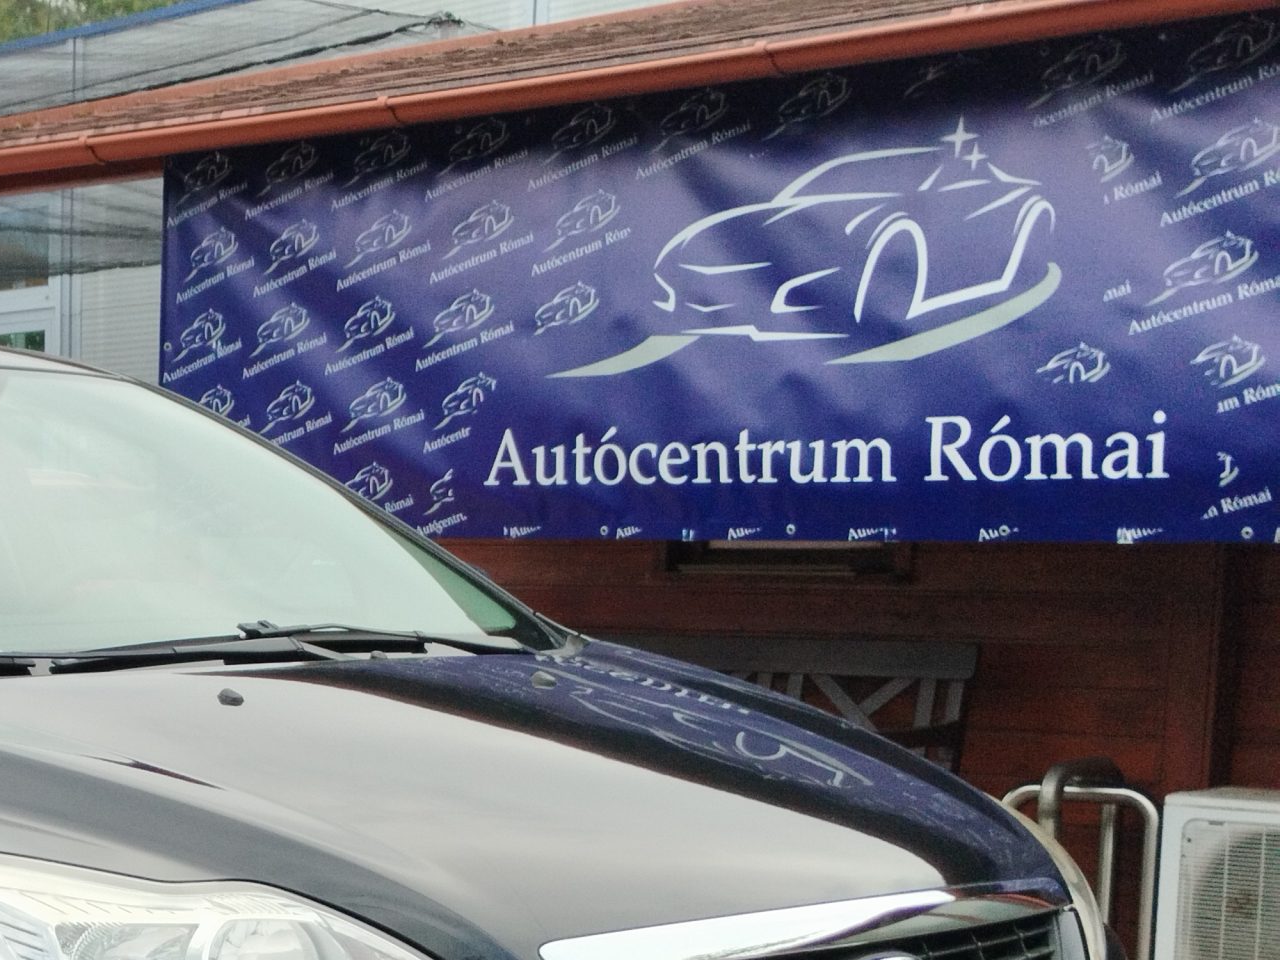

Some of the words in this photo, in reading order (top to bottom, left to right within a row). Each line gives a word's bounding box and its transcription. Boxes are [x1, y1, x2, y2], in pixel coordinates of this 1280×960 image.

[1160, 180, 1260, 227] Autócentrum
[176, 271, 225, 304] Autócentrum
[227, 256, 255, 277] Római
[252, 264, 307, 298] Autócentrum
[308, 248, 337, 271] Római
[336, 254, 397, 292] Autócentrum
[399, 240, 431, 264] Római
[429, 248, 497, 284] Autócentrum
[499, 231, 534, 255] Római
[530, 238, 603, 277] Autócentrum
[1128, 292, 1233, 336] Autócentrum
[1237, 274, 1280, 300] Róma
[242, 349, 295, 380] Autócentrum
[297, 331, 328, 354] Római
[324, 341, 384, 376] Autócentrum
[385, 326, 415, 351] Római
[415, 335, 478, 372] Autócentrum
[480, 320, 515, 344] Római
[305, 411, 332, 433] Római
[333, 425, 391, 455] Autócentrum
[393, 409, 424, 431] Római
[484, 425, 897, 486] Autócentrum
[924, 410, 1170, 482] Római
[384, 493, 414, 514] Római
[1221, 485, 1272, 514] Római
